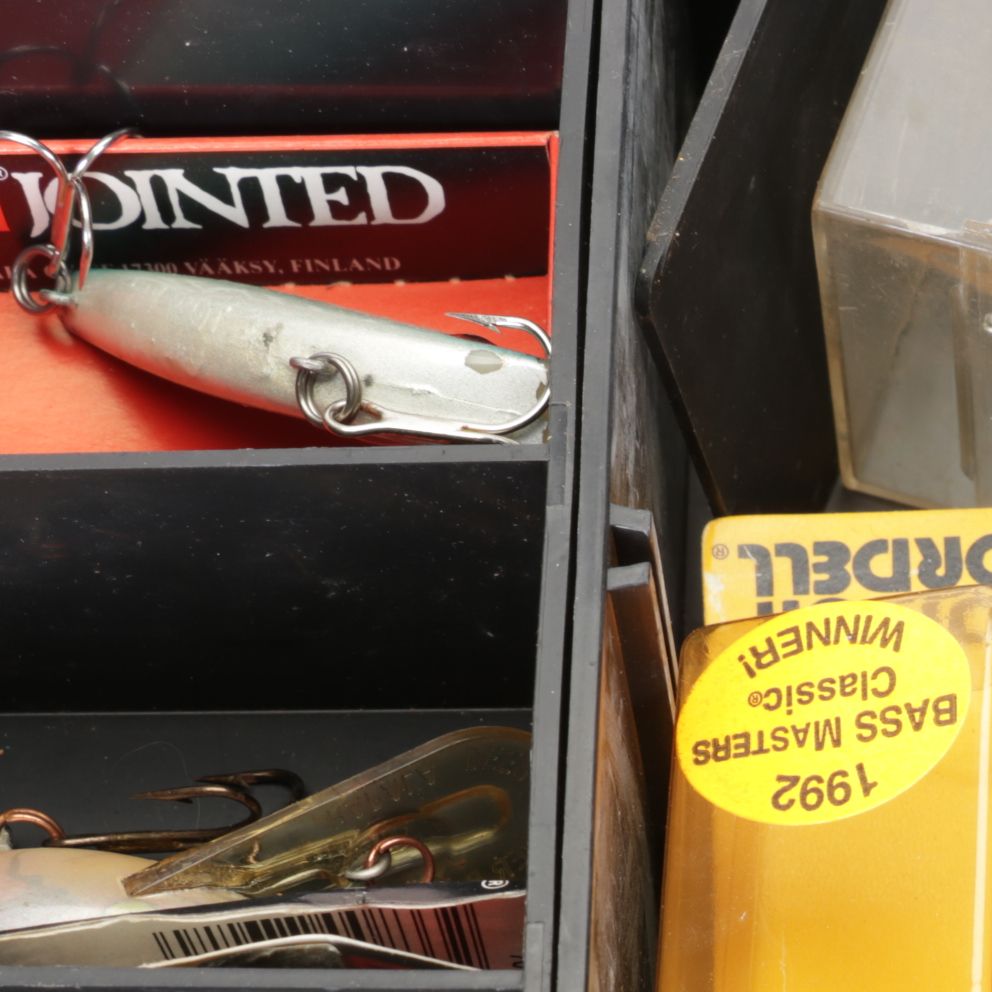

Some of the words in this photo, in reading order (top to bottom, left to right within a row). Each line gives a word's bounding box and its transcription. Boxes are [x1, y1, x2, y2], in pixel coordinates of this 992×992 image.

[11, 165, 445, 238] JOINTED
[290, 256, 401, 273] FINLAND
[737, 614, 906, 680] WINNER!
[691, 716, 842, 766] MASTERS
[856, 693, 958, 743] BASS
[771, 762, 880, 813] 1992
